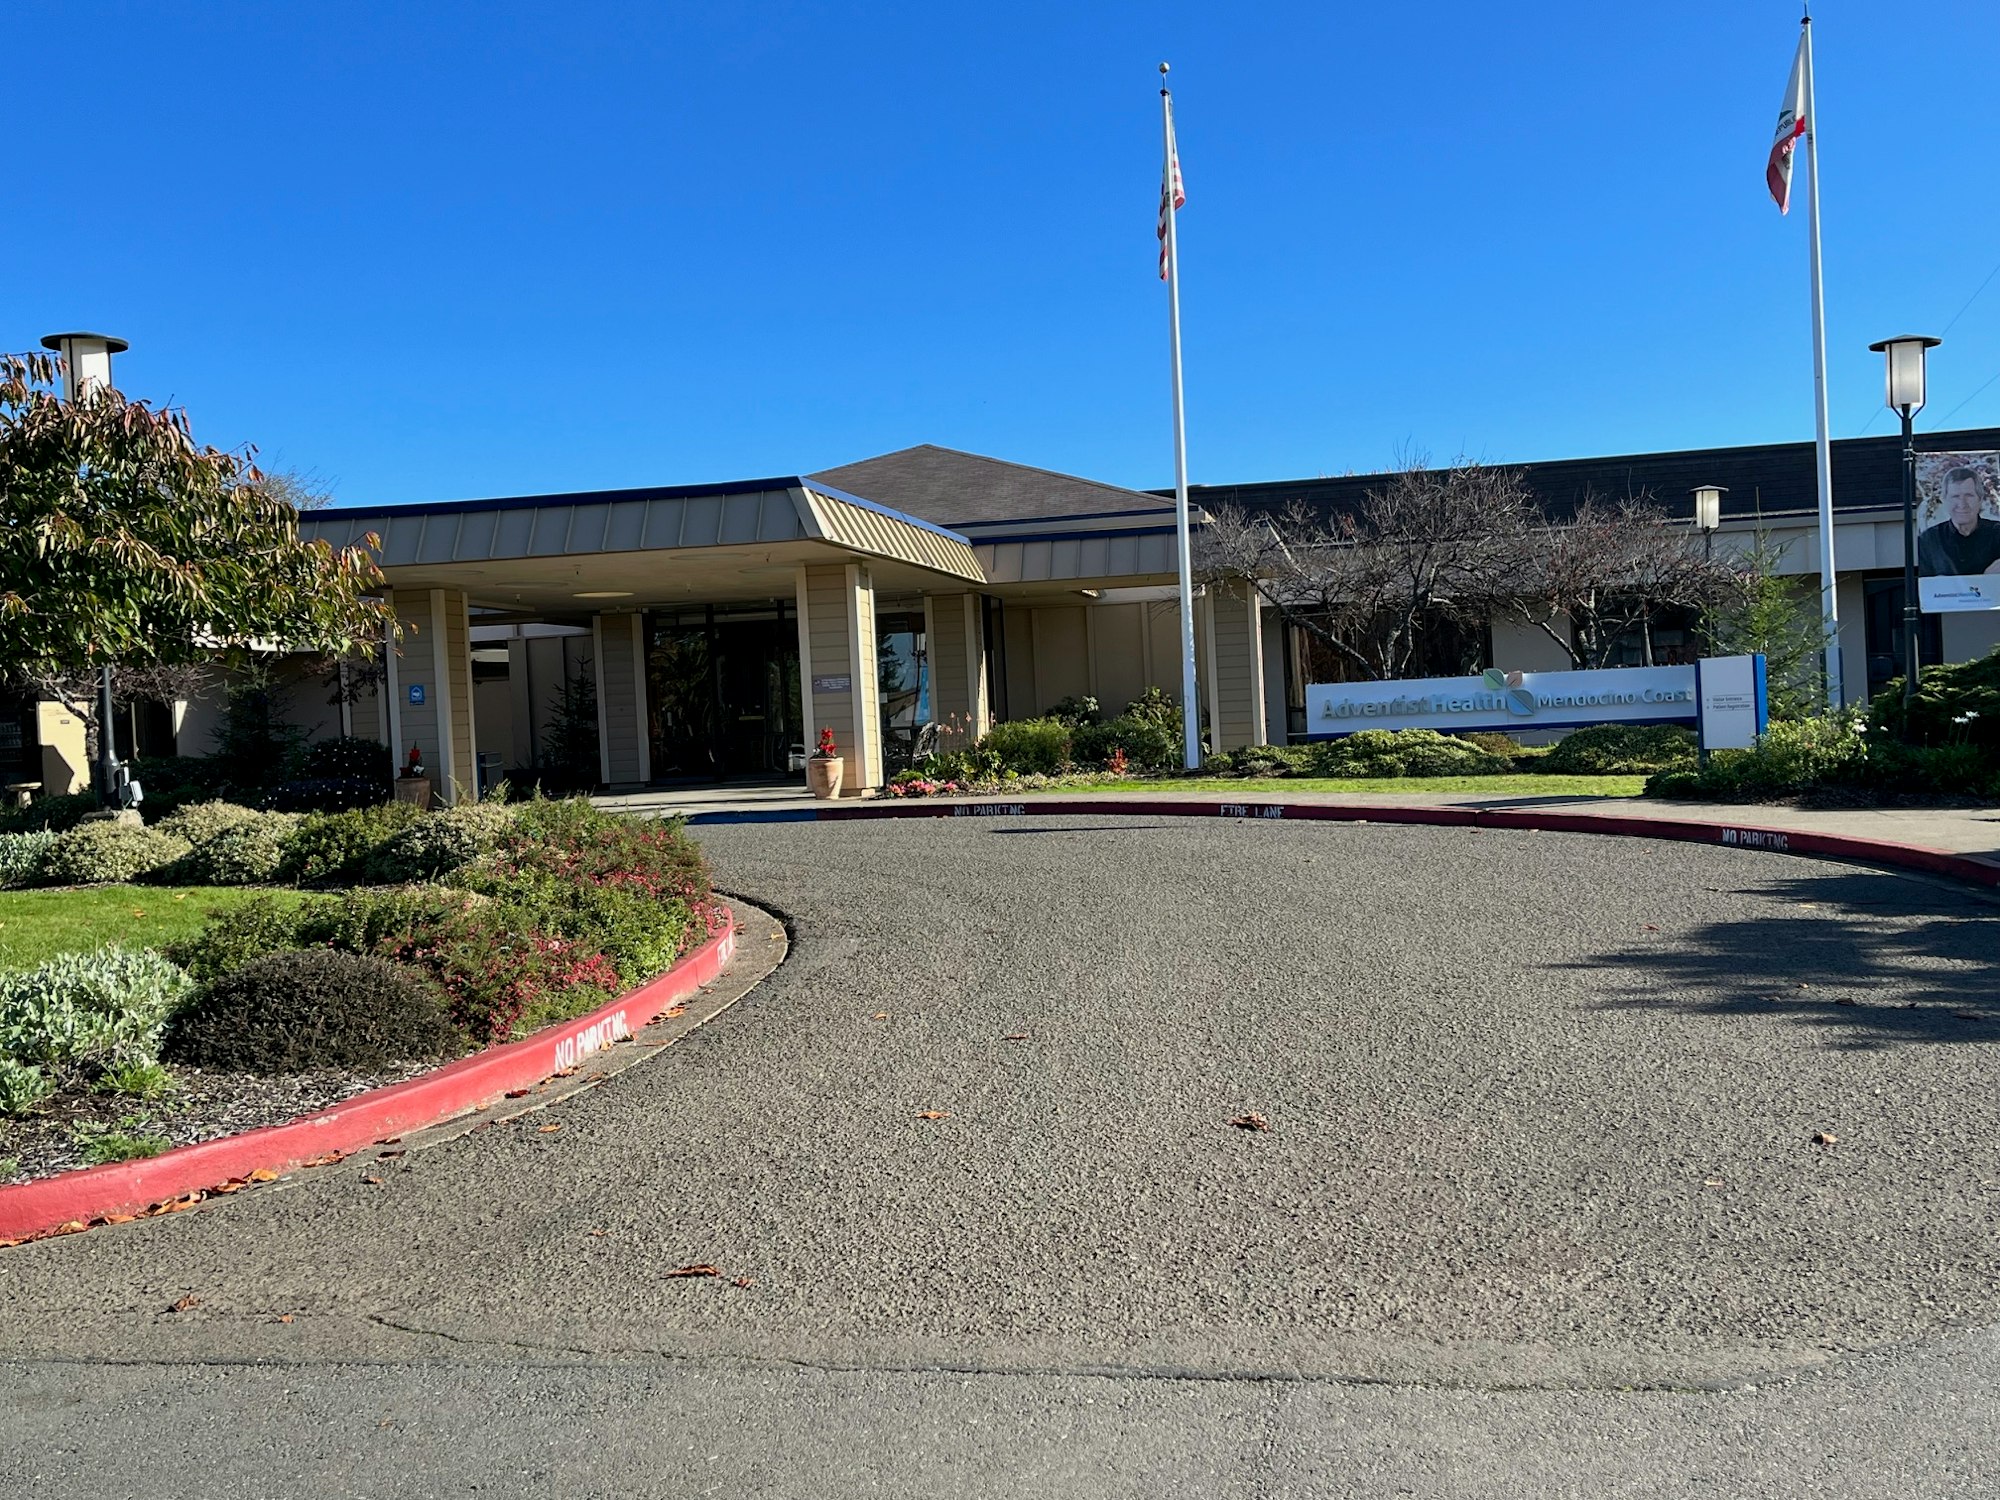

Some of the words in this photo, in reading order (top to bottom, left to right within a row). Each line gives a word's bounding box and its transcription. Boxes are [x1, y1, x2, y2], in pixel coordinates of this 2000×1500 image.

[1321, 695, 1430, 719] Adventist
[1431, 691, 1507, 714] Health
[1537, 689, 1636, 709] Mendocino
[1641, 687, 1693, 705] Coast
[954, 805, 970, 817] NO
[973, 804, 1026, 816] PARKING
[1220, 804, 1249, 817] FIRE
[1255, 806, 1285, 819] LANE
[1722, 828, 1737, 843] NO
[1740, 830, 1789, 849] PARKING
[554, 1037, 574, 1072] NO
[576, 1009, 628, 1060] PARKING
